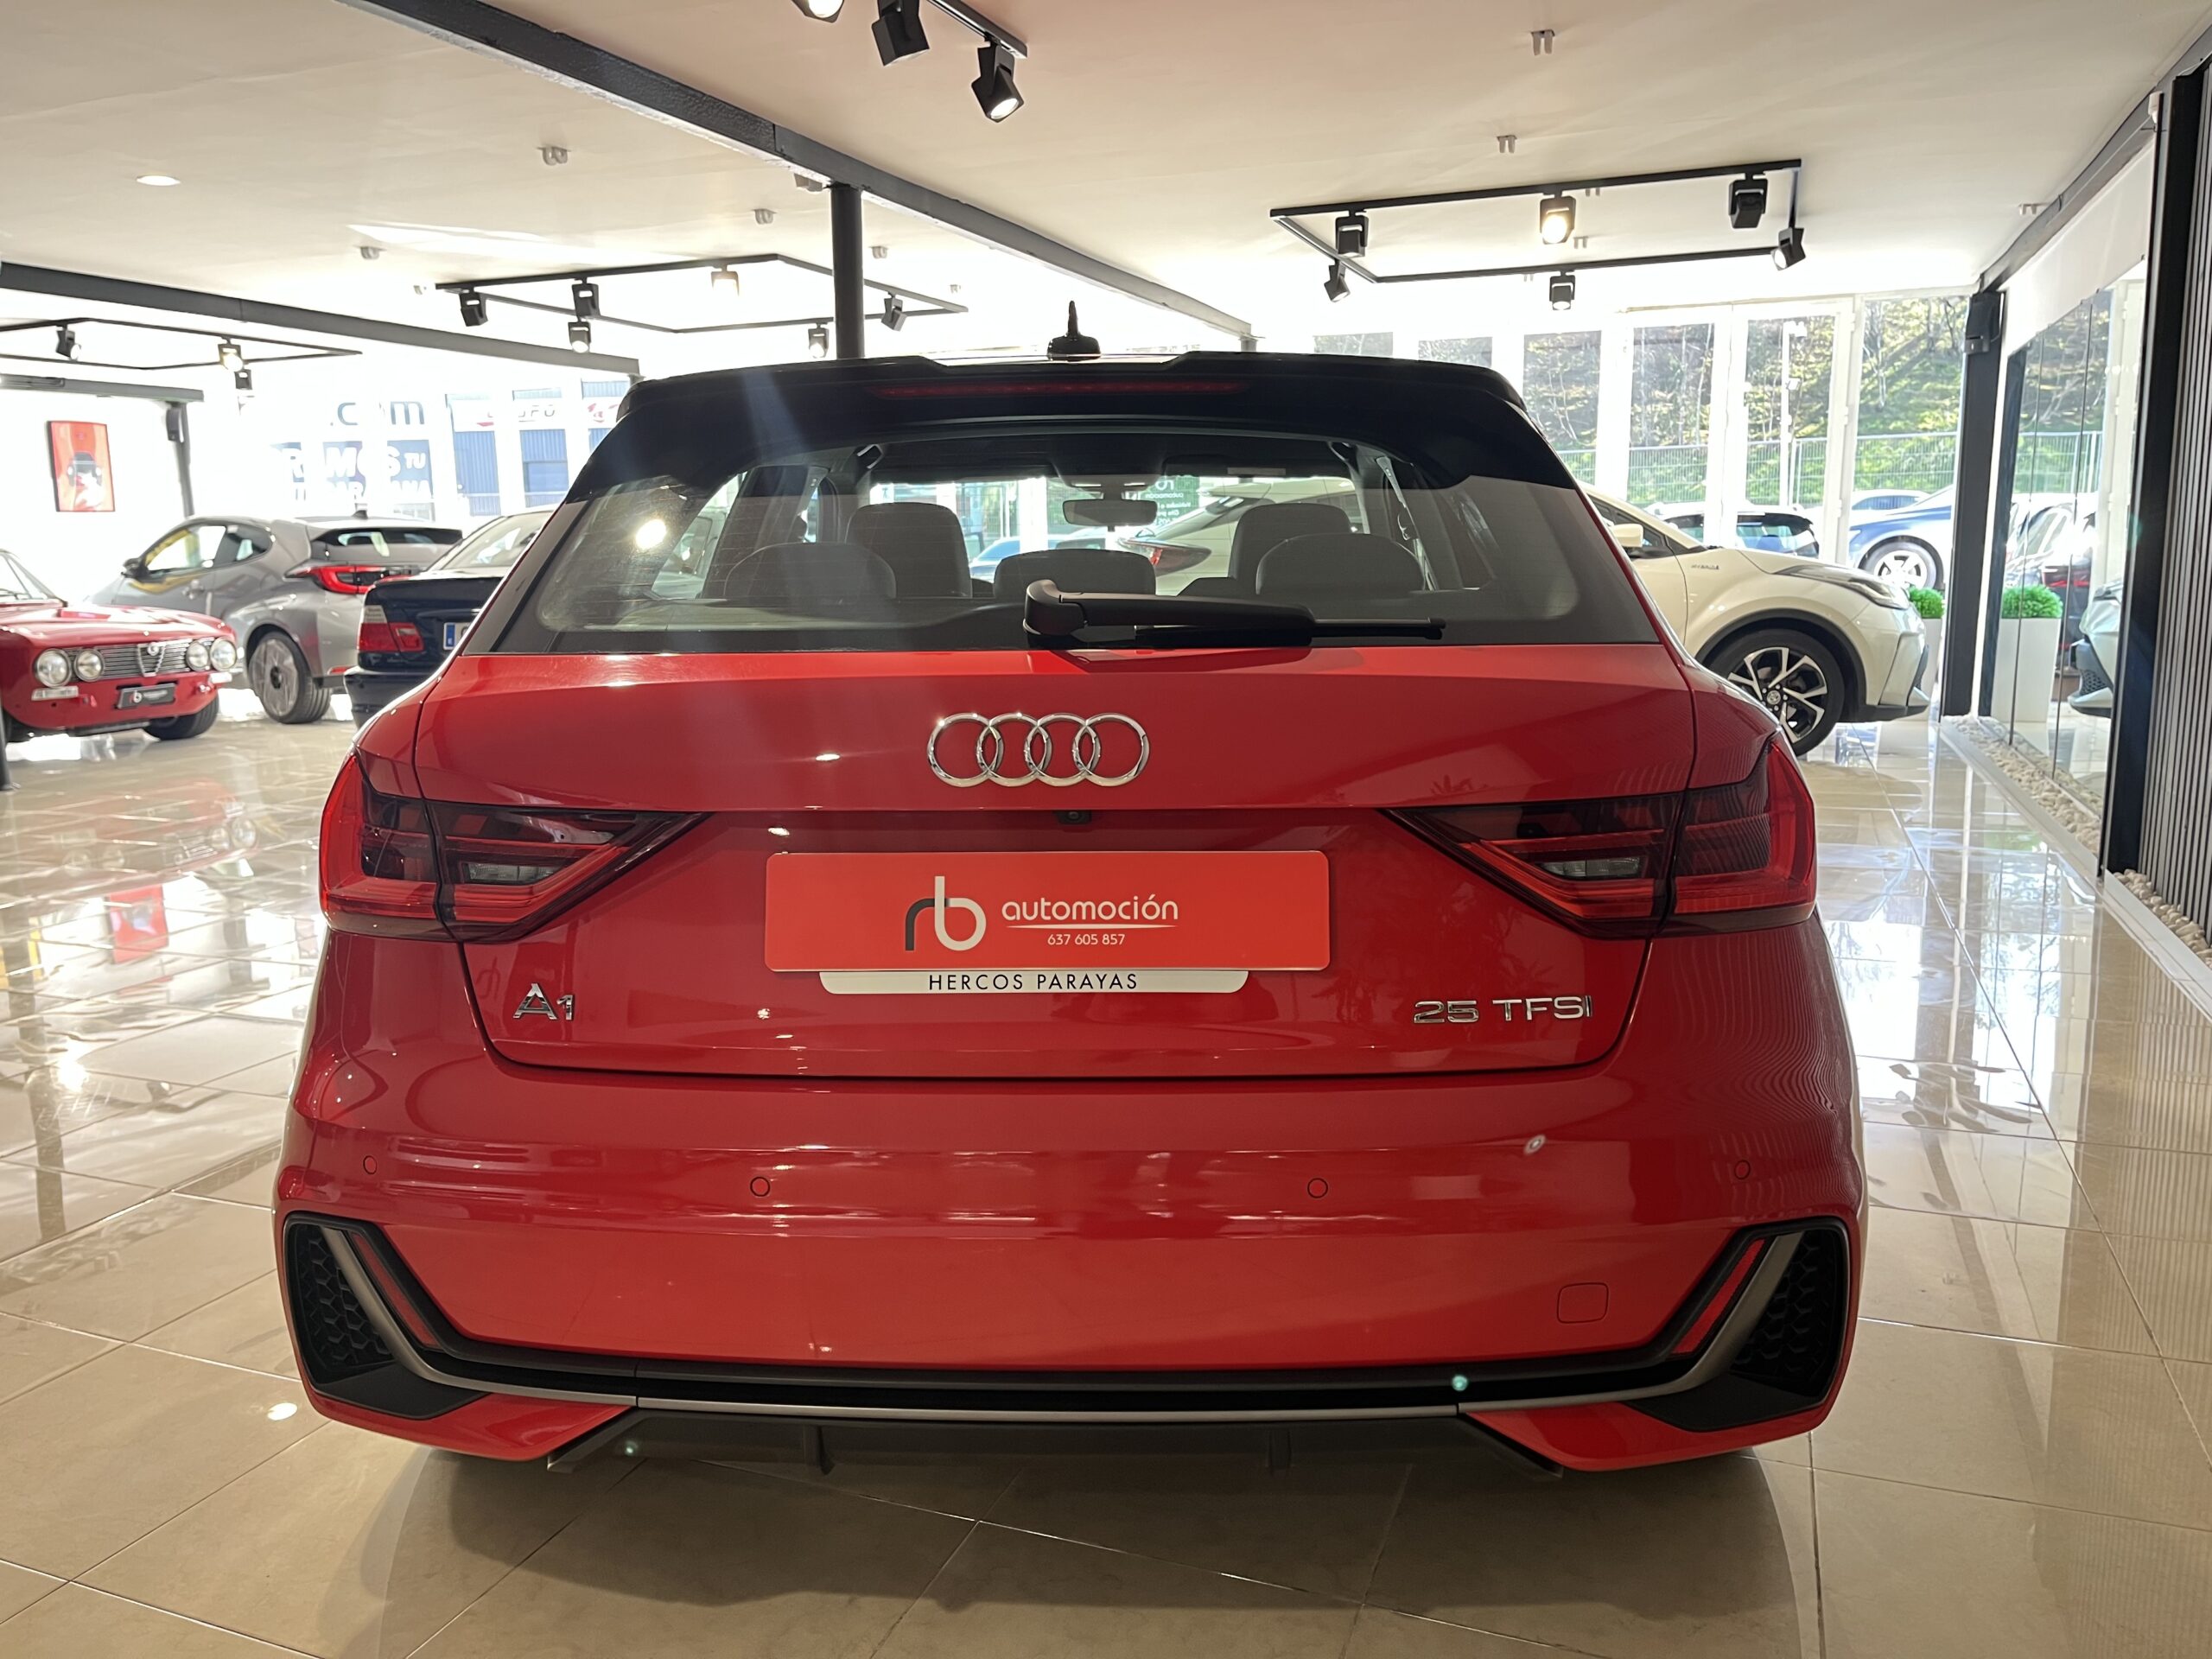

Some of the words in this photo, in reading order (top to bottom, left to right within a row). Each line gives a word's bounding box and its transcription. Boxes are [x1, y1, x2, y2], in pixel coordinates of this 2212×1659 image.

[1001, 893, 1179, 921] automoción
[1047, 933, 1071, 945] 637
[1074, 933, 1098, 945] 605
[1102, 933, 1125, 945] 857
[928, 974, 1024, 991] HERCOS
[1037, 973, 1138, 990] PARAYAS
[512, 982, 574, 1020] A1
[1414, 1000, 1479, 1023] 25
[1492, 995, 1592, 1021] TFSI
